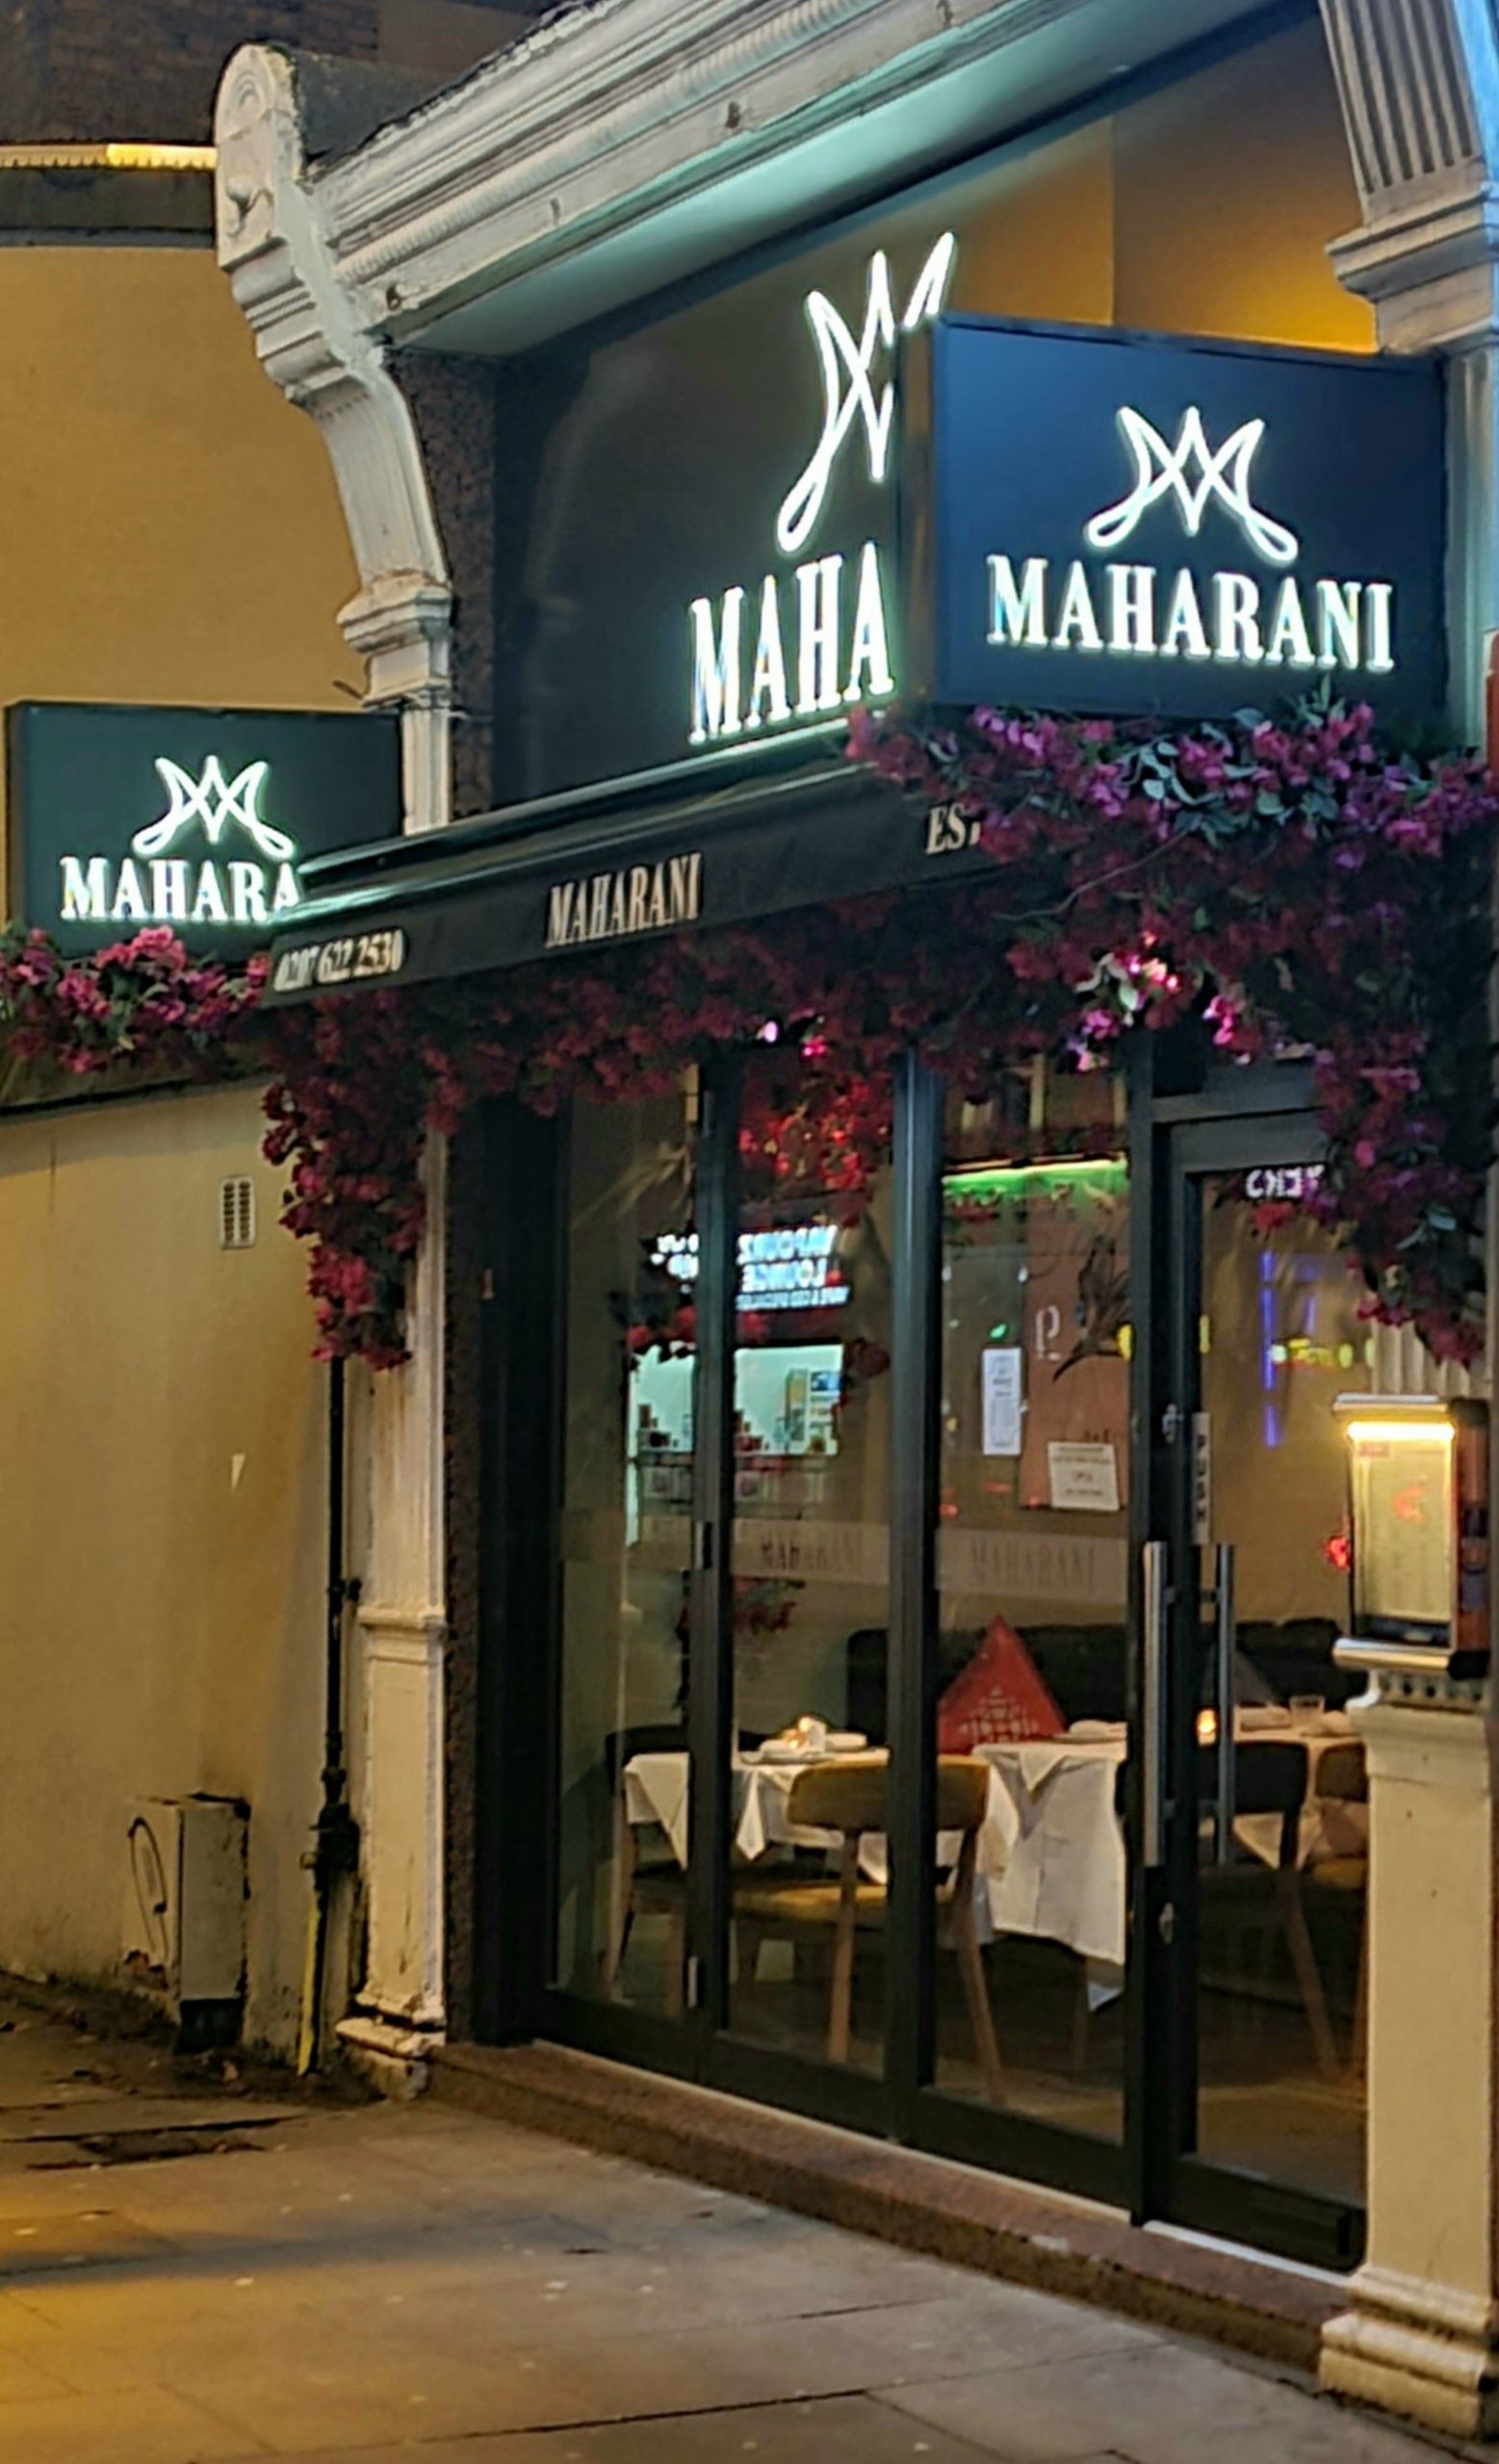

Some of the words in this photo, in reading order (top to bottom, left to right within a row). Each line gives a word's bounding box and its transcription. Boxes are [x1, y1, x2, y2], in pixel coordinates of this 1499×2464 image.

[688, 541, 895, 746] MAHA
[986, 553, 1396, 673] MAHARANI
[59, 855, 300, 924] MAHARA
[545, 853, 701, 948] MAHARANI
